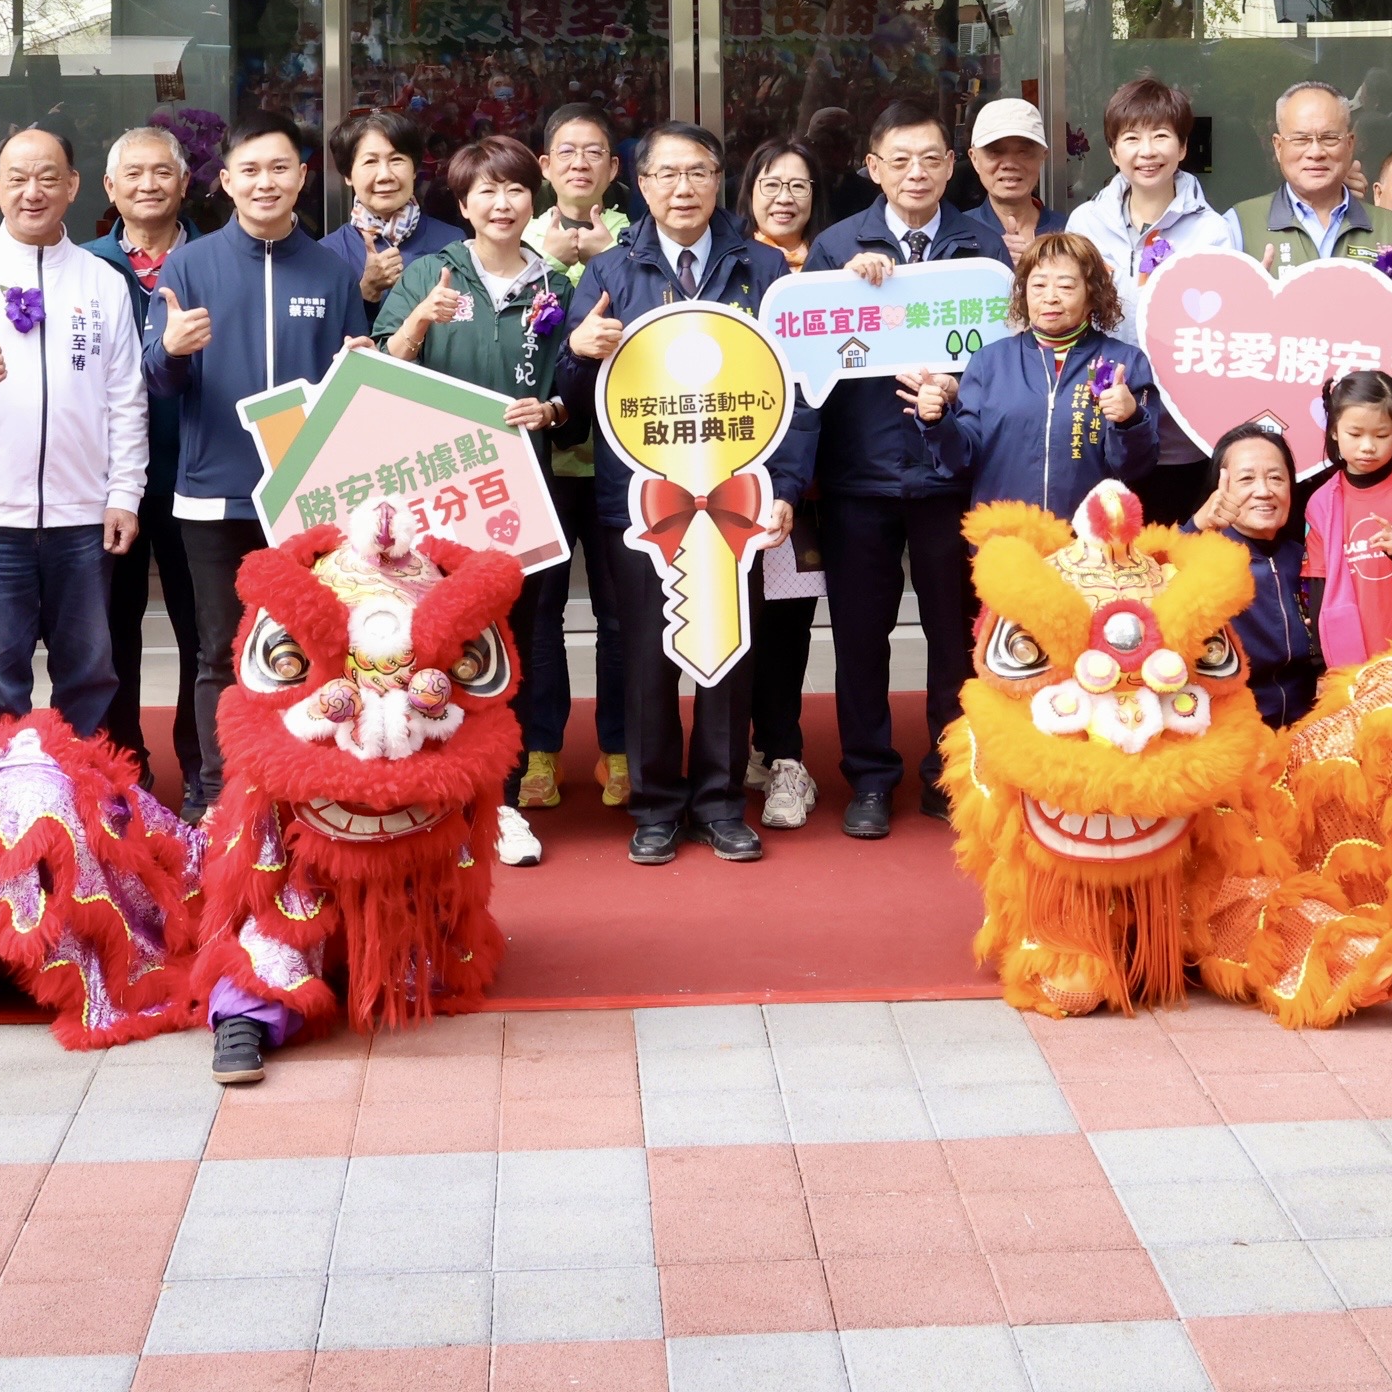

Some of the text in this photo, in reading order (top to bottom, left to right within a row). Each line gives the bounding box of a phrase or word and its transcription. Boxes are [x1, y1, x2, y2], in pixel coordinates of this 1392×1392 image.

[71, 315, 87, 371] 許至椿
[90, 298, 102, 356] 台南市議員
[775, 305, 881, 339] 北區宜居
[905, 295, 1010, 329] 樂活勝安
[1172, 326, 1382, 386] 我愛勝安
[620, 389, 776, 419] 勝安社區活動中心
[642, 415, 756, 446] 啟用典禮
[295, 428, 500, 529] 勝安新據點
